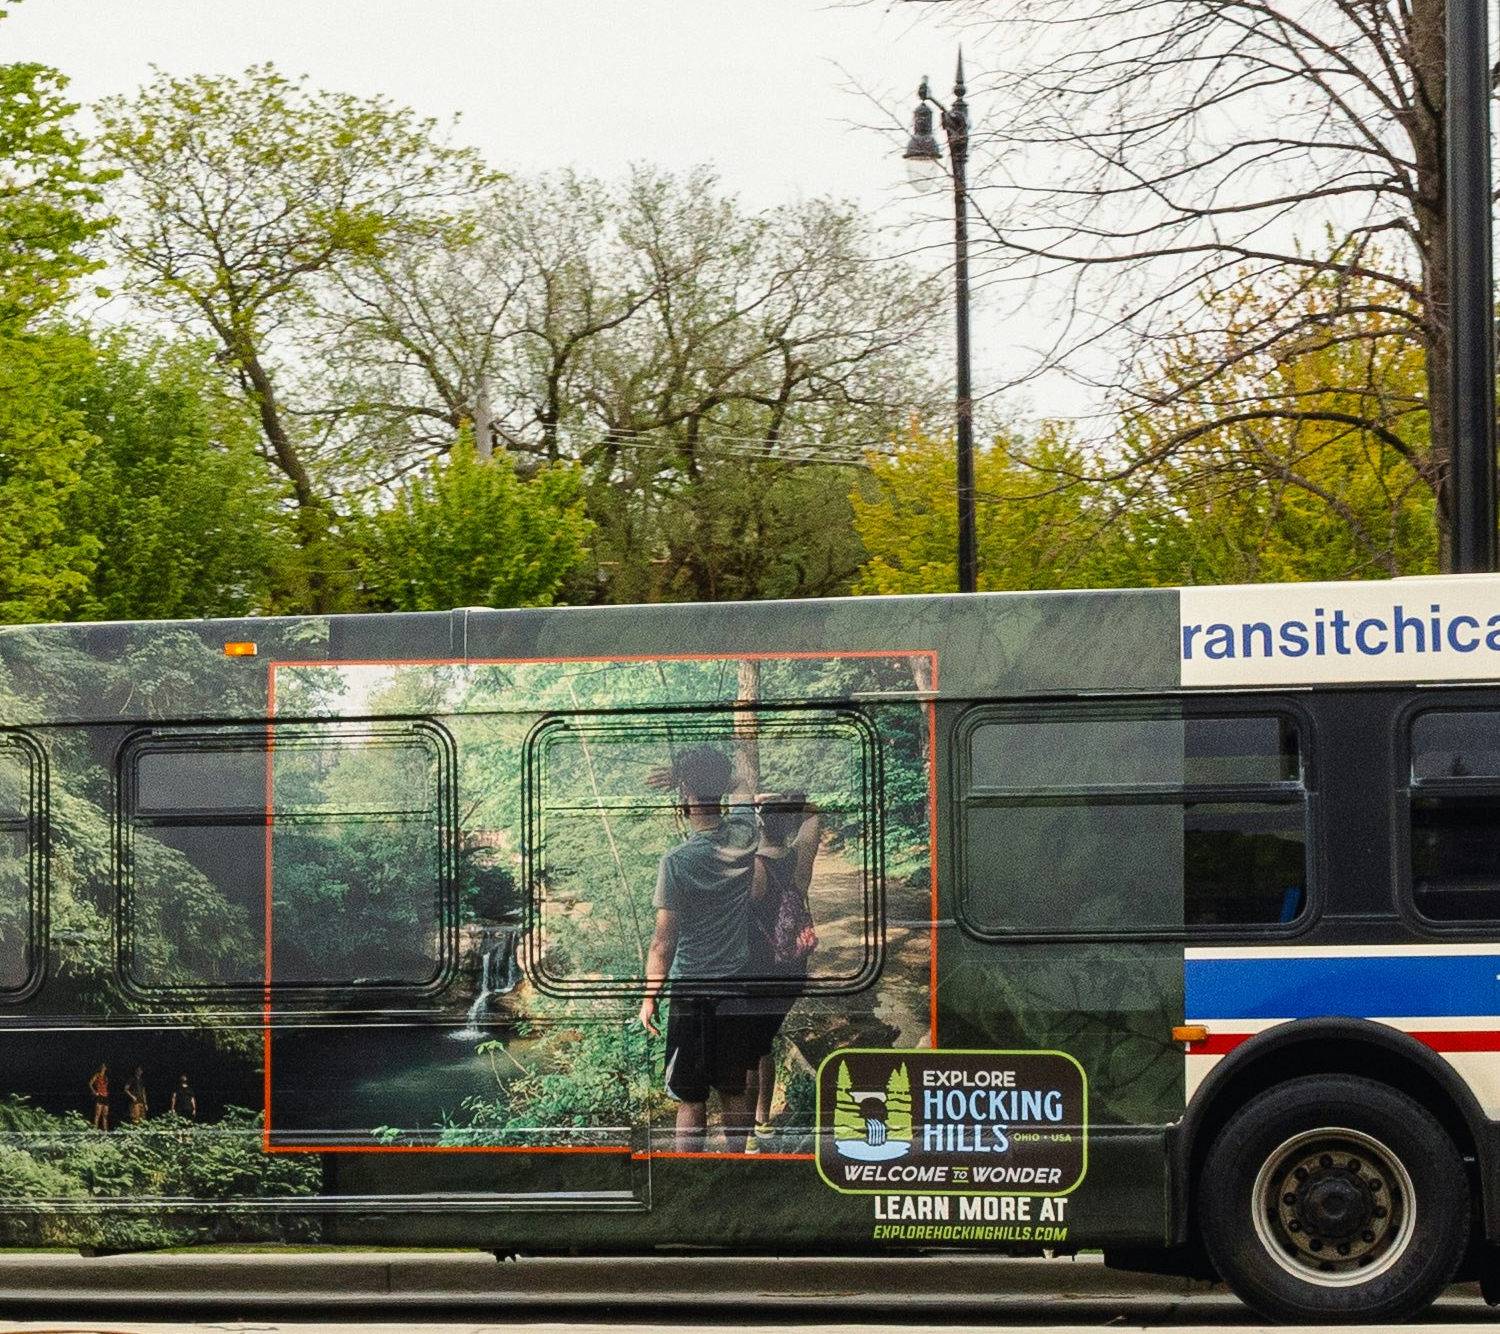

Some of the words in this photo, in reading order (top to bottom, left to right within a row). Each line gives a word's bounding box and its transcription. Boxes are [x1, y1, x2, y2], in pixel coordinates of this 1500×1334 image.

[922, 1070, 1016, 1088] EXPLORE
[923, 1089, 1063, 1122] HOCKING
[922, 1123, 1009, 1153] HILLS
[1013, 1132, 1040, 1142] OHIO
[1051, 1133, 1072, 1142] USA
[844, 1165, 949, 1182] WELCOME
[953, 1170, 968, 1180] TO
[972, 1166, 1062, 1185] WONDER
[874, 1195, 950, 1221] LEARN
[959, 1196, 1031, 1222] MORE
[1039, 1197, 1069, 1223] AT
[873, 1224, 1068, 1242] EXPLOREHOCKINGHILLS.COM
